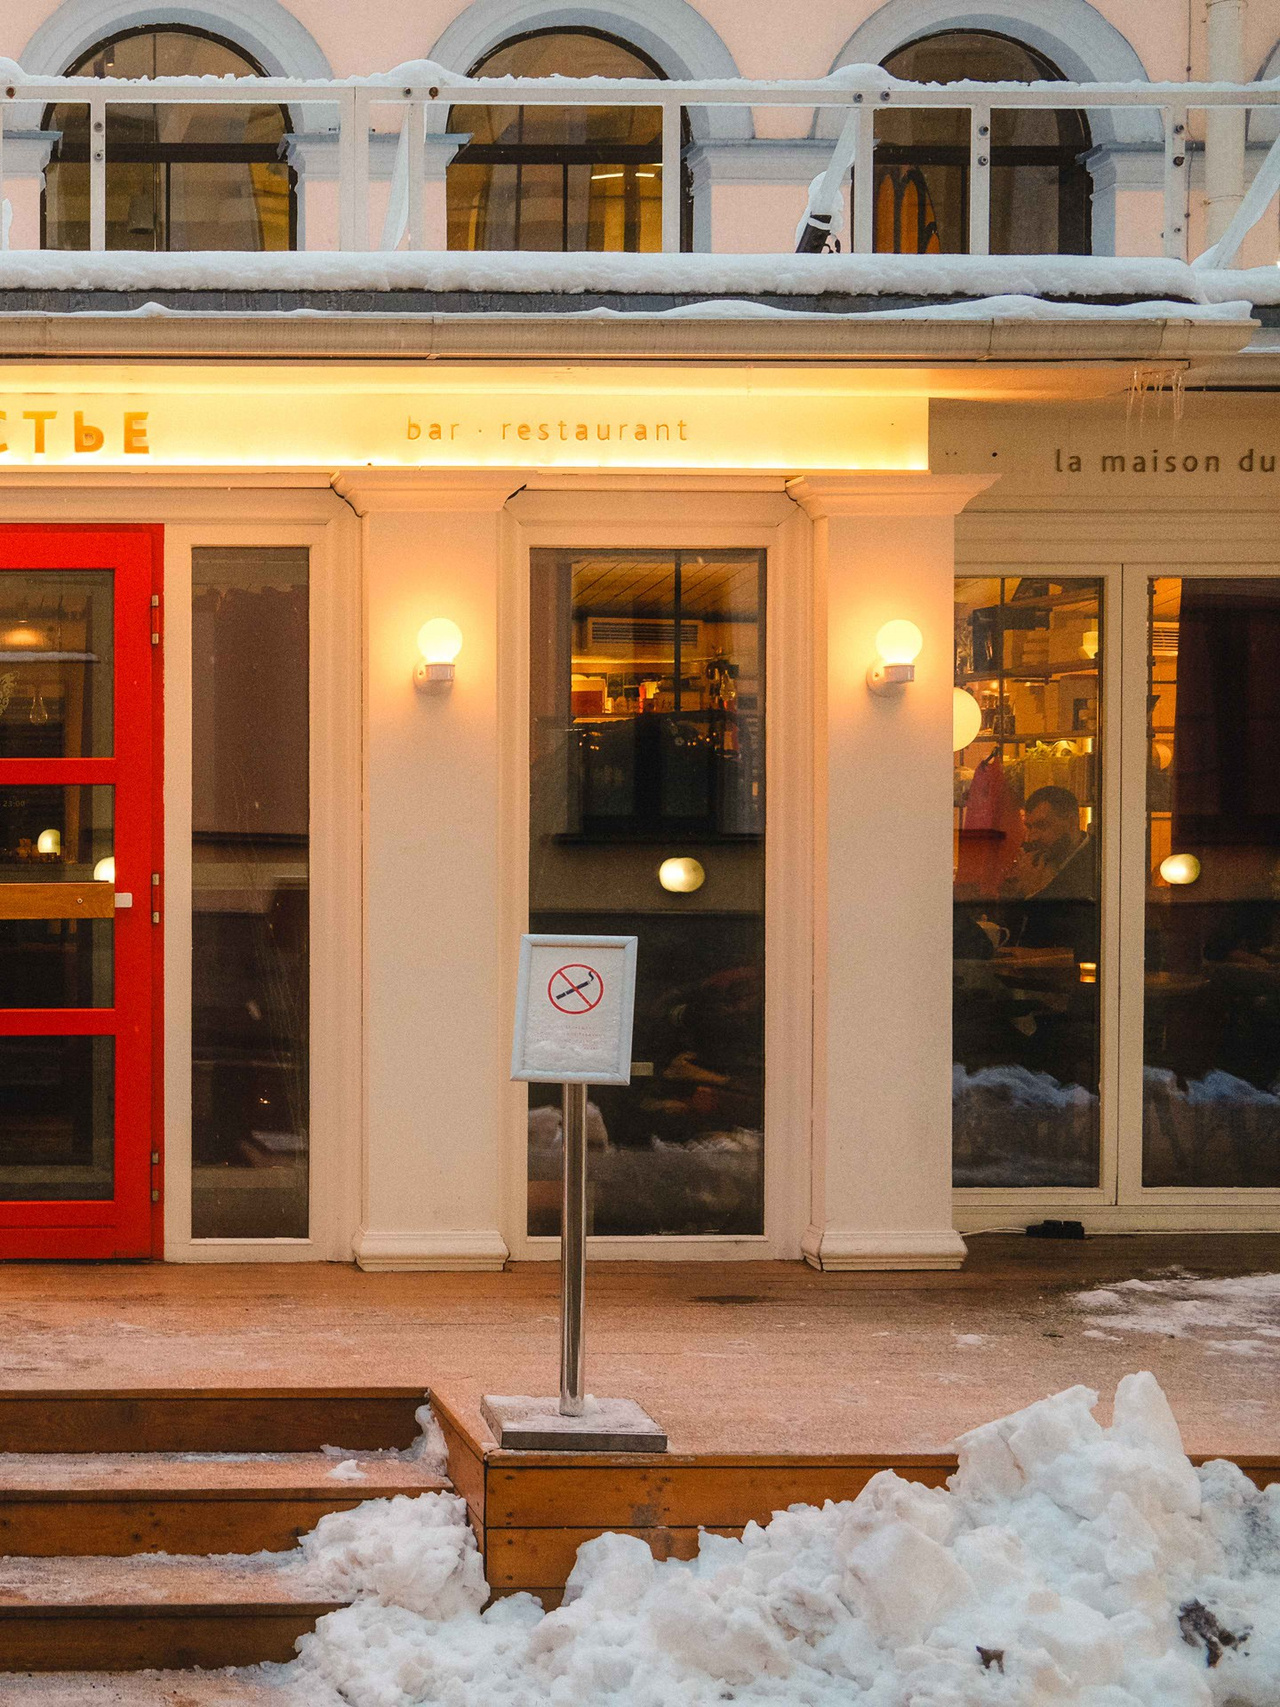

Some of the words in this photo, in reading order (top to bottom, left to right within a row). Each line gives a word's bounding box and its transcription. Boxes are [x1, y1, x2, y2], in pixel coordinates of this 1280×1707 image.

[406, 415, 460, 441] bar
[500, 418, 688, 442] restaurant
[1054, 448, 1083, 473] la
[1101, 448, 1221, 473] maison
[1238, 448, 1276, 473] du
